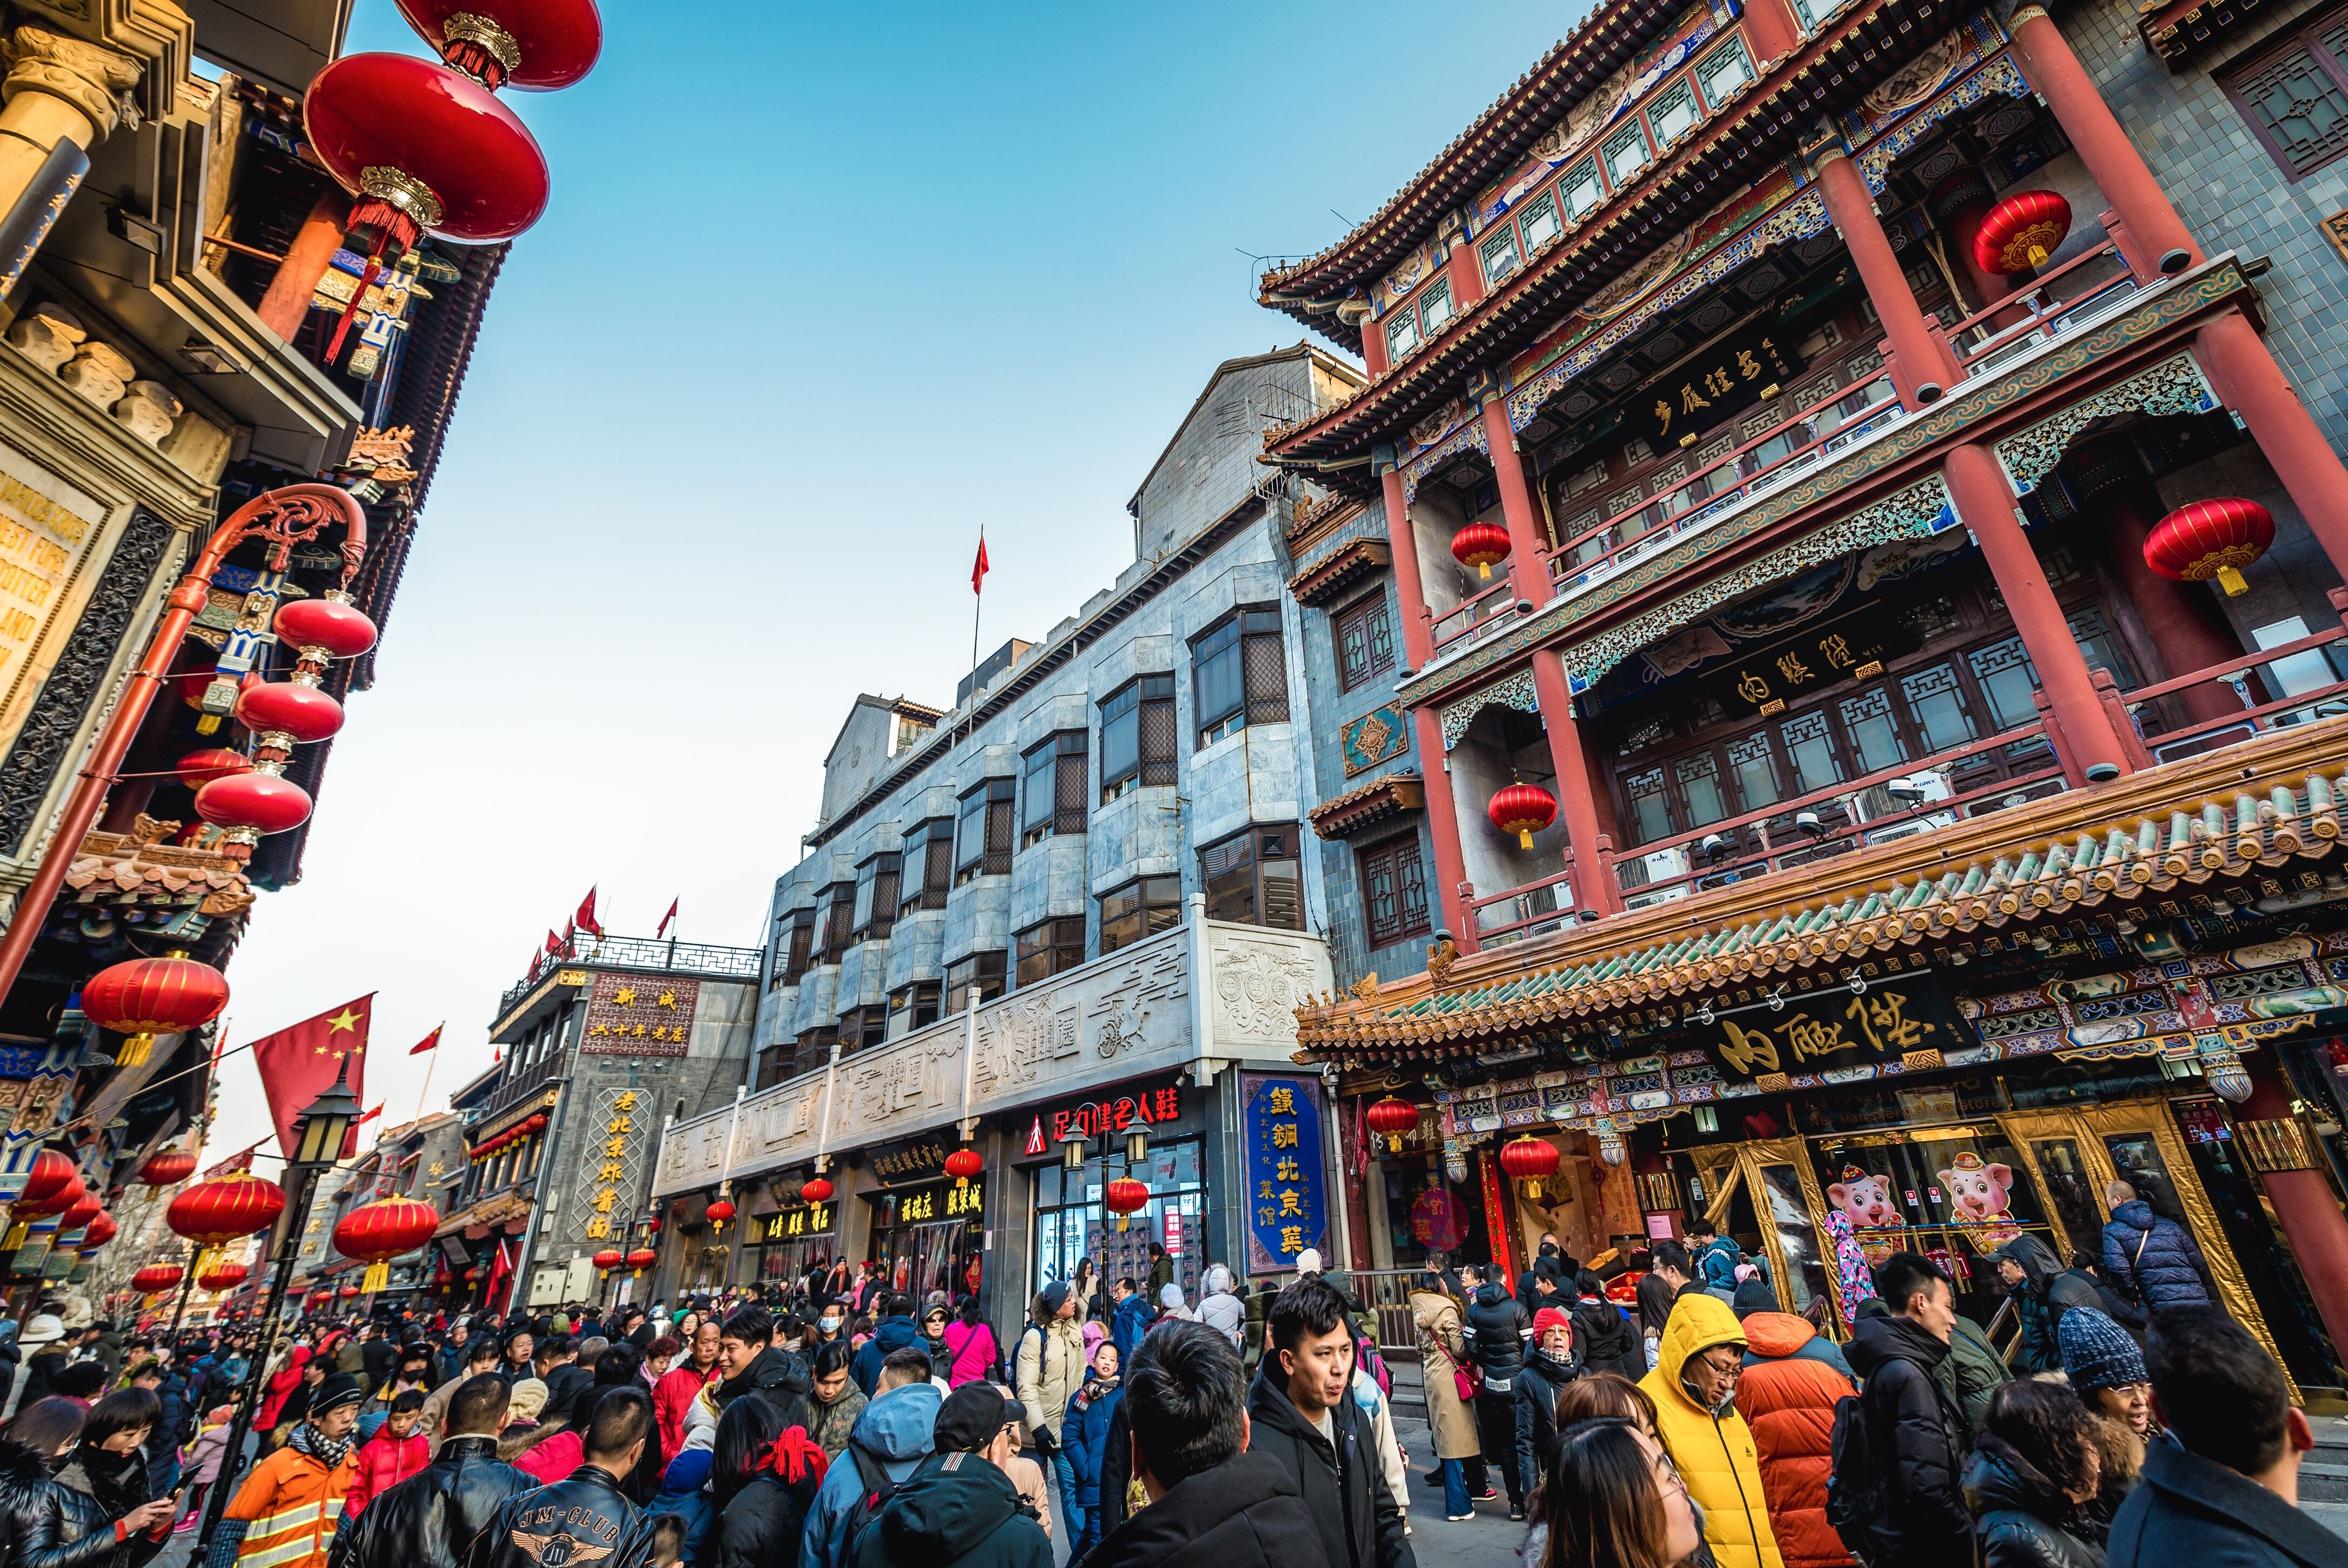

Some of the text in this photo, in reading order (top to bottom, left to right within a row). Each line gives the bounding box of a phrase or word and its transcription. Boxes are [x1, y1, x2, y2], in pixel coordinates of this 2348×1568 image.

[1919, 779, 1936, 787] GREE
[589, 1022, 683, 1042] 六十年老店
[1054, 1087, 1179, 1142] 足力健老人鞋
[520, 1505, 619, 1543] JM-CLUB
